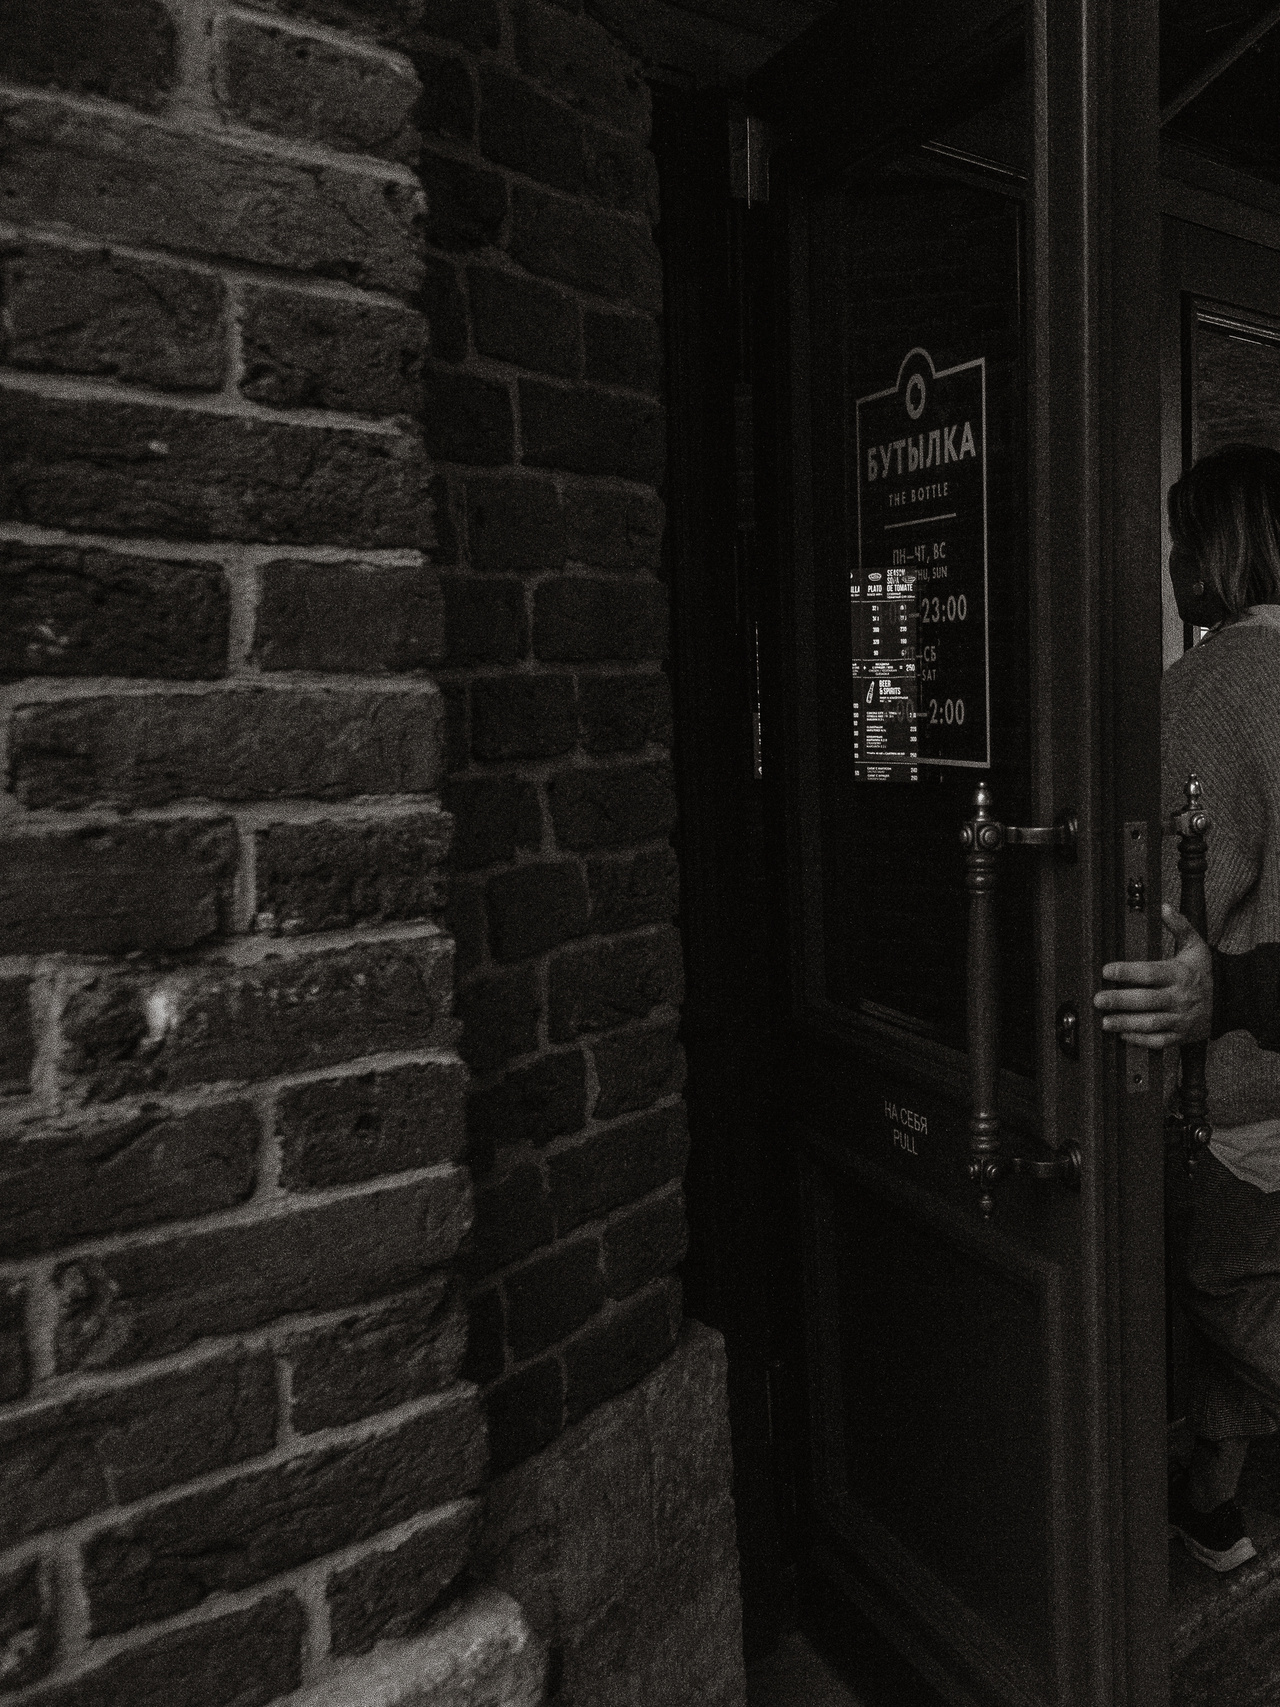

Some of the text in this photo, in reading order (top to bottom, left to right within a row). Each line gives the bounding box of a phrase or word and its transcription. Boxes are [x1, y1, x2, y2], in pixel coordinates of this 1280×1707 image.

[866, 421, 977, 482] БУТЫЛКА
[888, 482, 949, 507] THE BOTTLE
[933, 541, 946, 560] ВС
[932, 565, 948, 579] SUN
[867, 584, 883, 593] PLATO
[905, 663, 916, 672] 250
[878, 679, 892, 688] BEER
[884, 1100, 928, 1135] НА СЕБЯ
[893, 1128, 919, 1156] PULL
